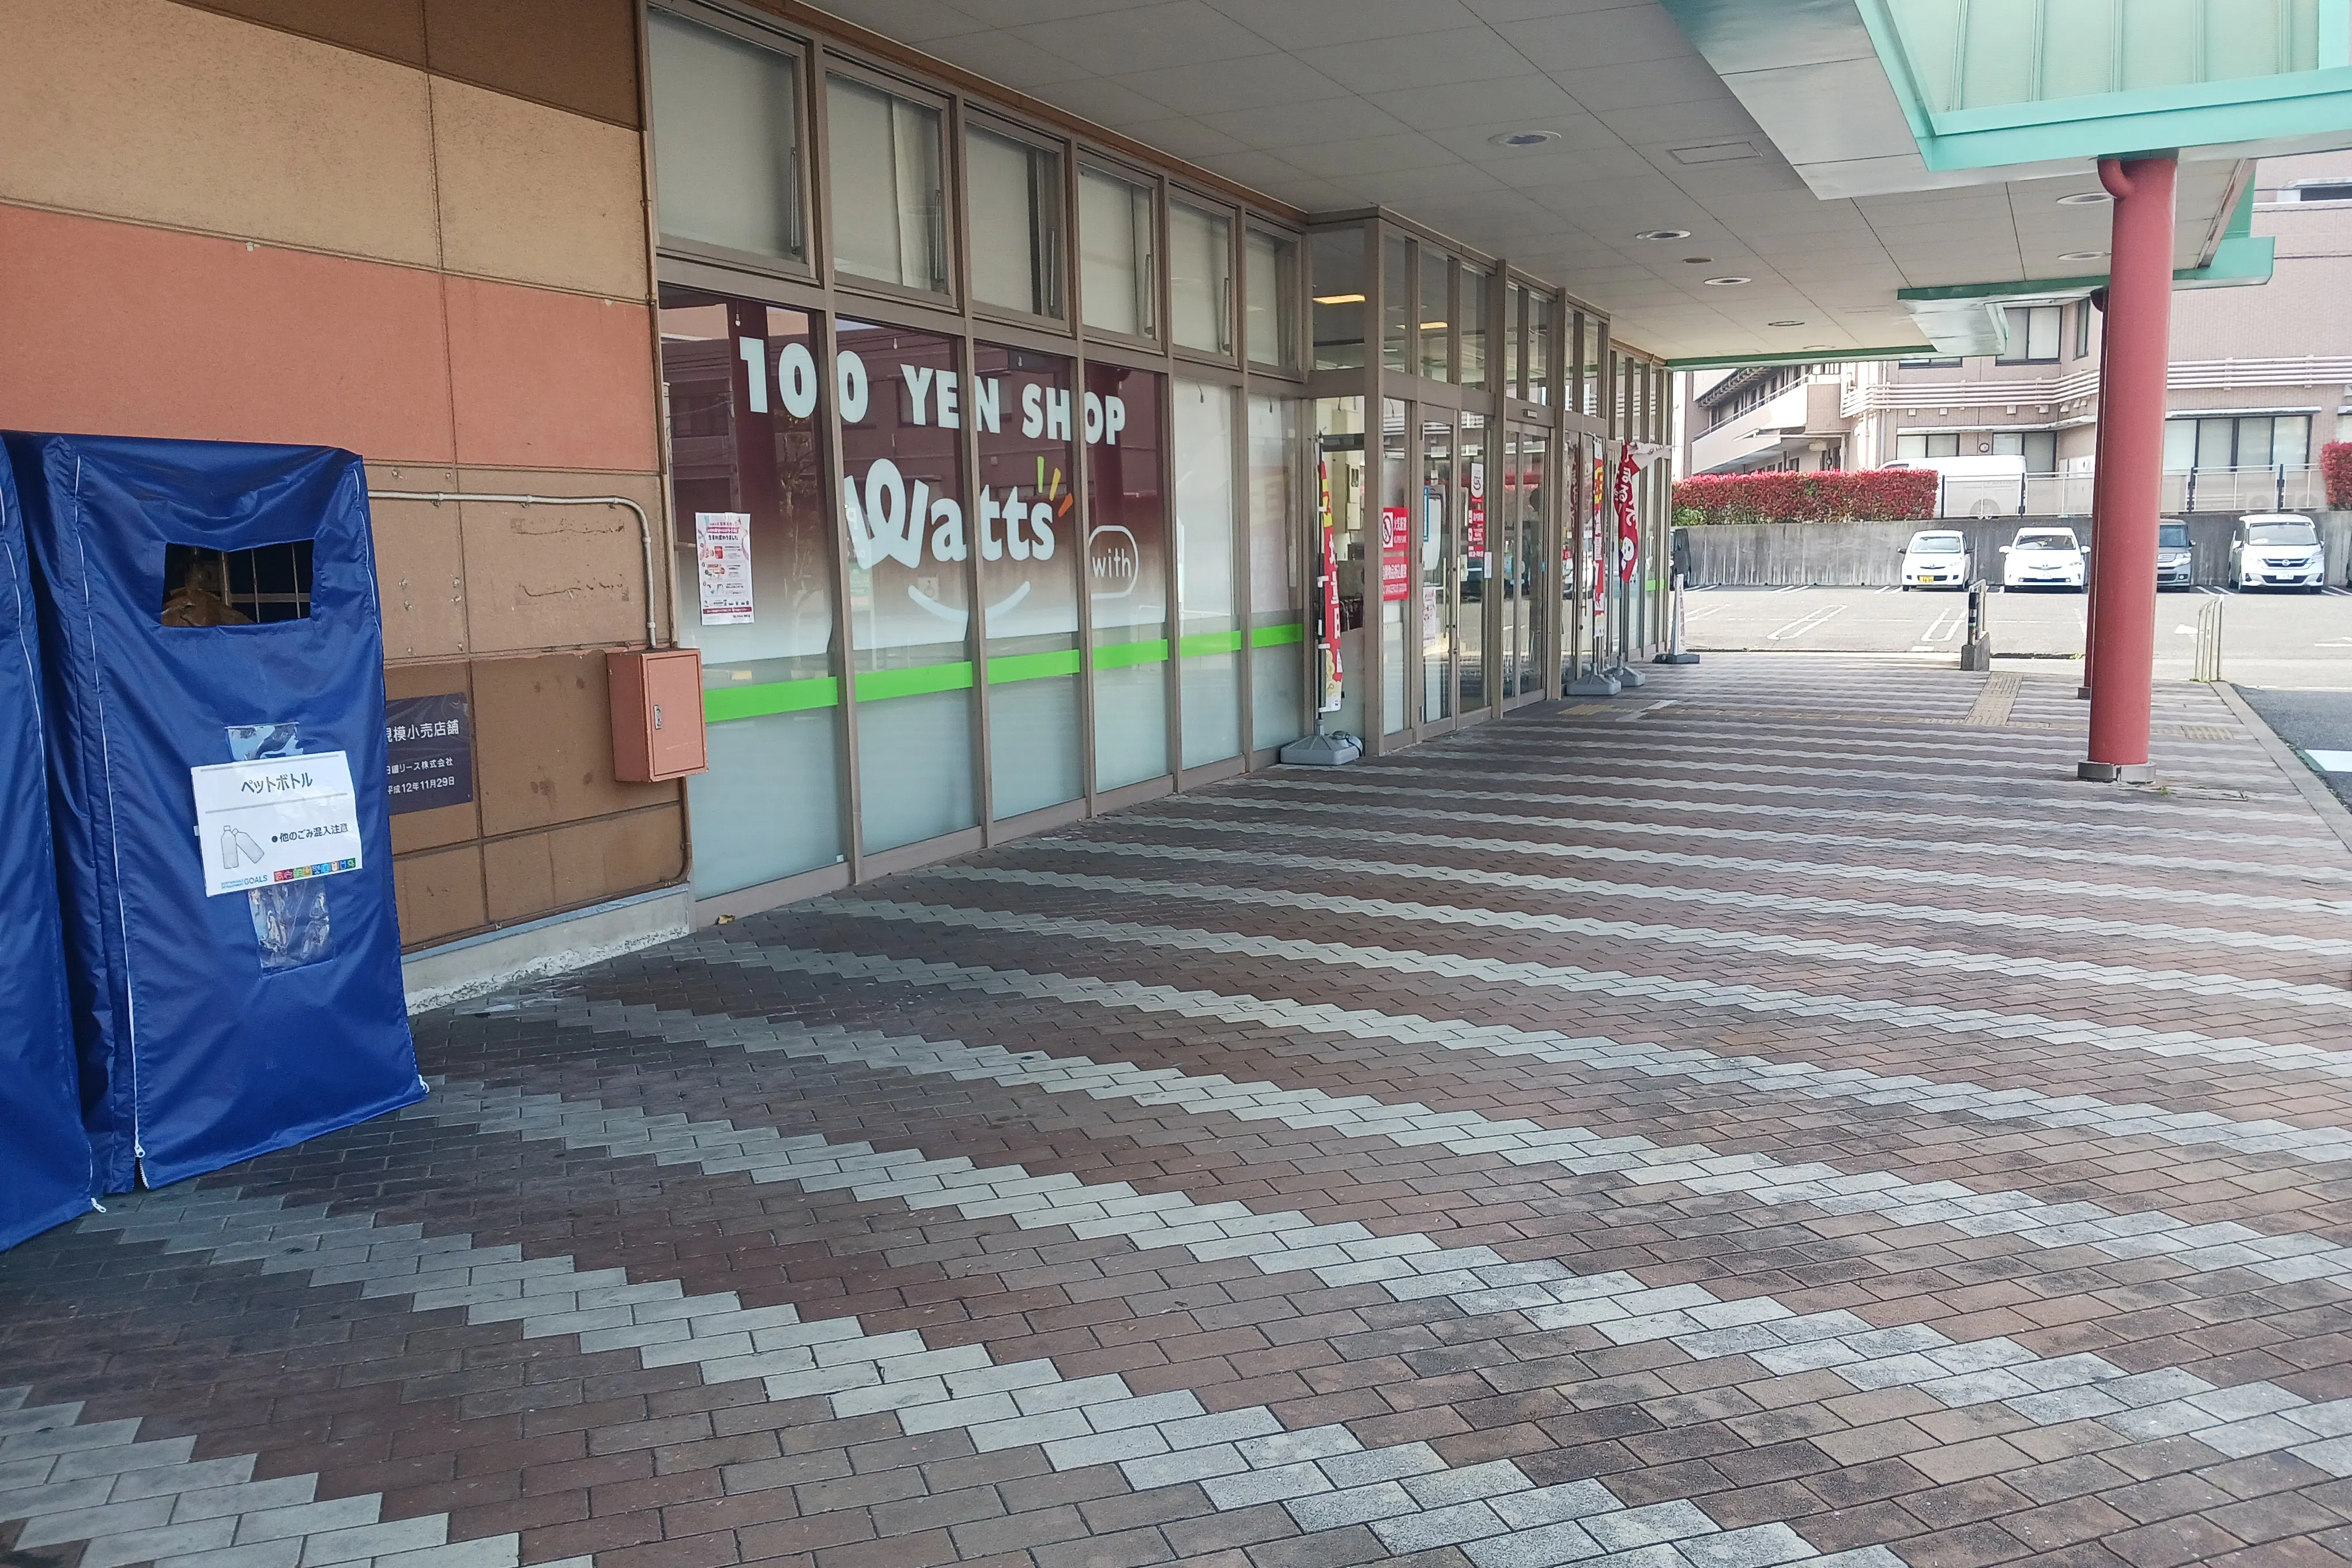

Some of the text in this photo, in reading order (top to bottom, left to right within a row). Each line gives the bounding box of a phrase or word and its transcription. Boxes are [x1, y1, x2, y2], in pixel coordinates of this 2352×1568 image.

[740, 337, 1125, 445] 100 YEN SHOP
[844, 458, 1055, 569] Watts
[1092, 547, 1132, 578] with
[242, 772, 312, 794] ペットボトル
[387, 776, 455, 795] 平成12年11月29日
[280, 823, 349, 842] 他のごみ混入注意
[244, 875, 268, 885] GOALS
